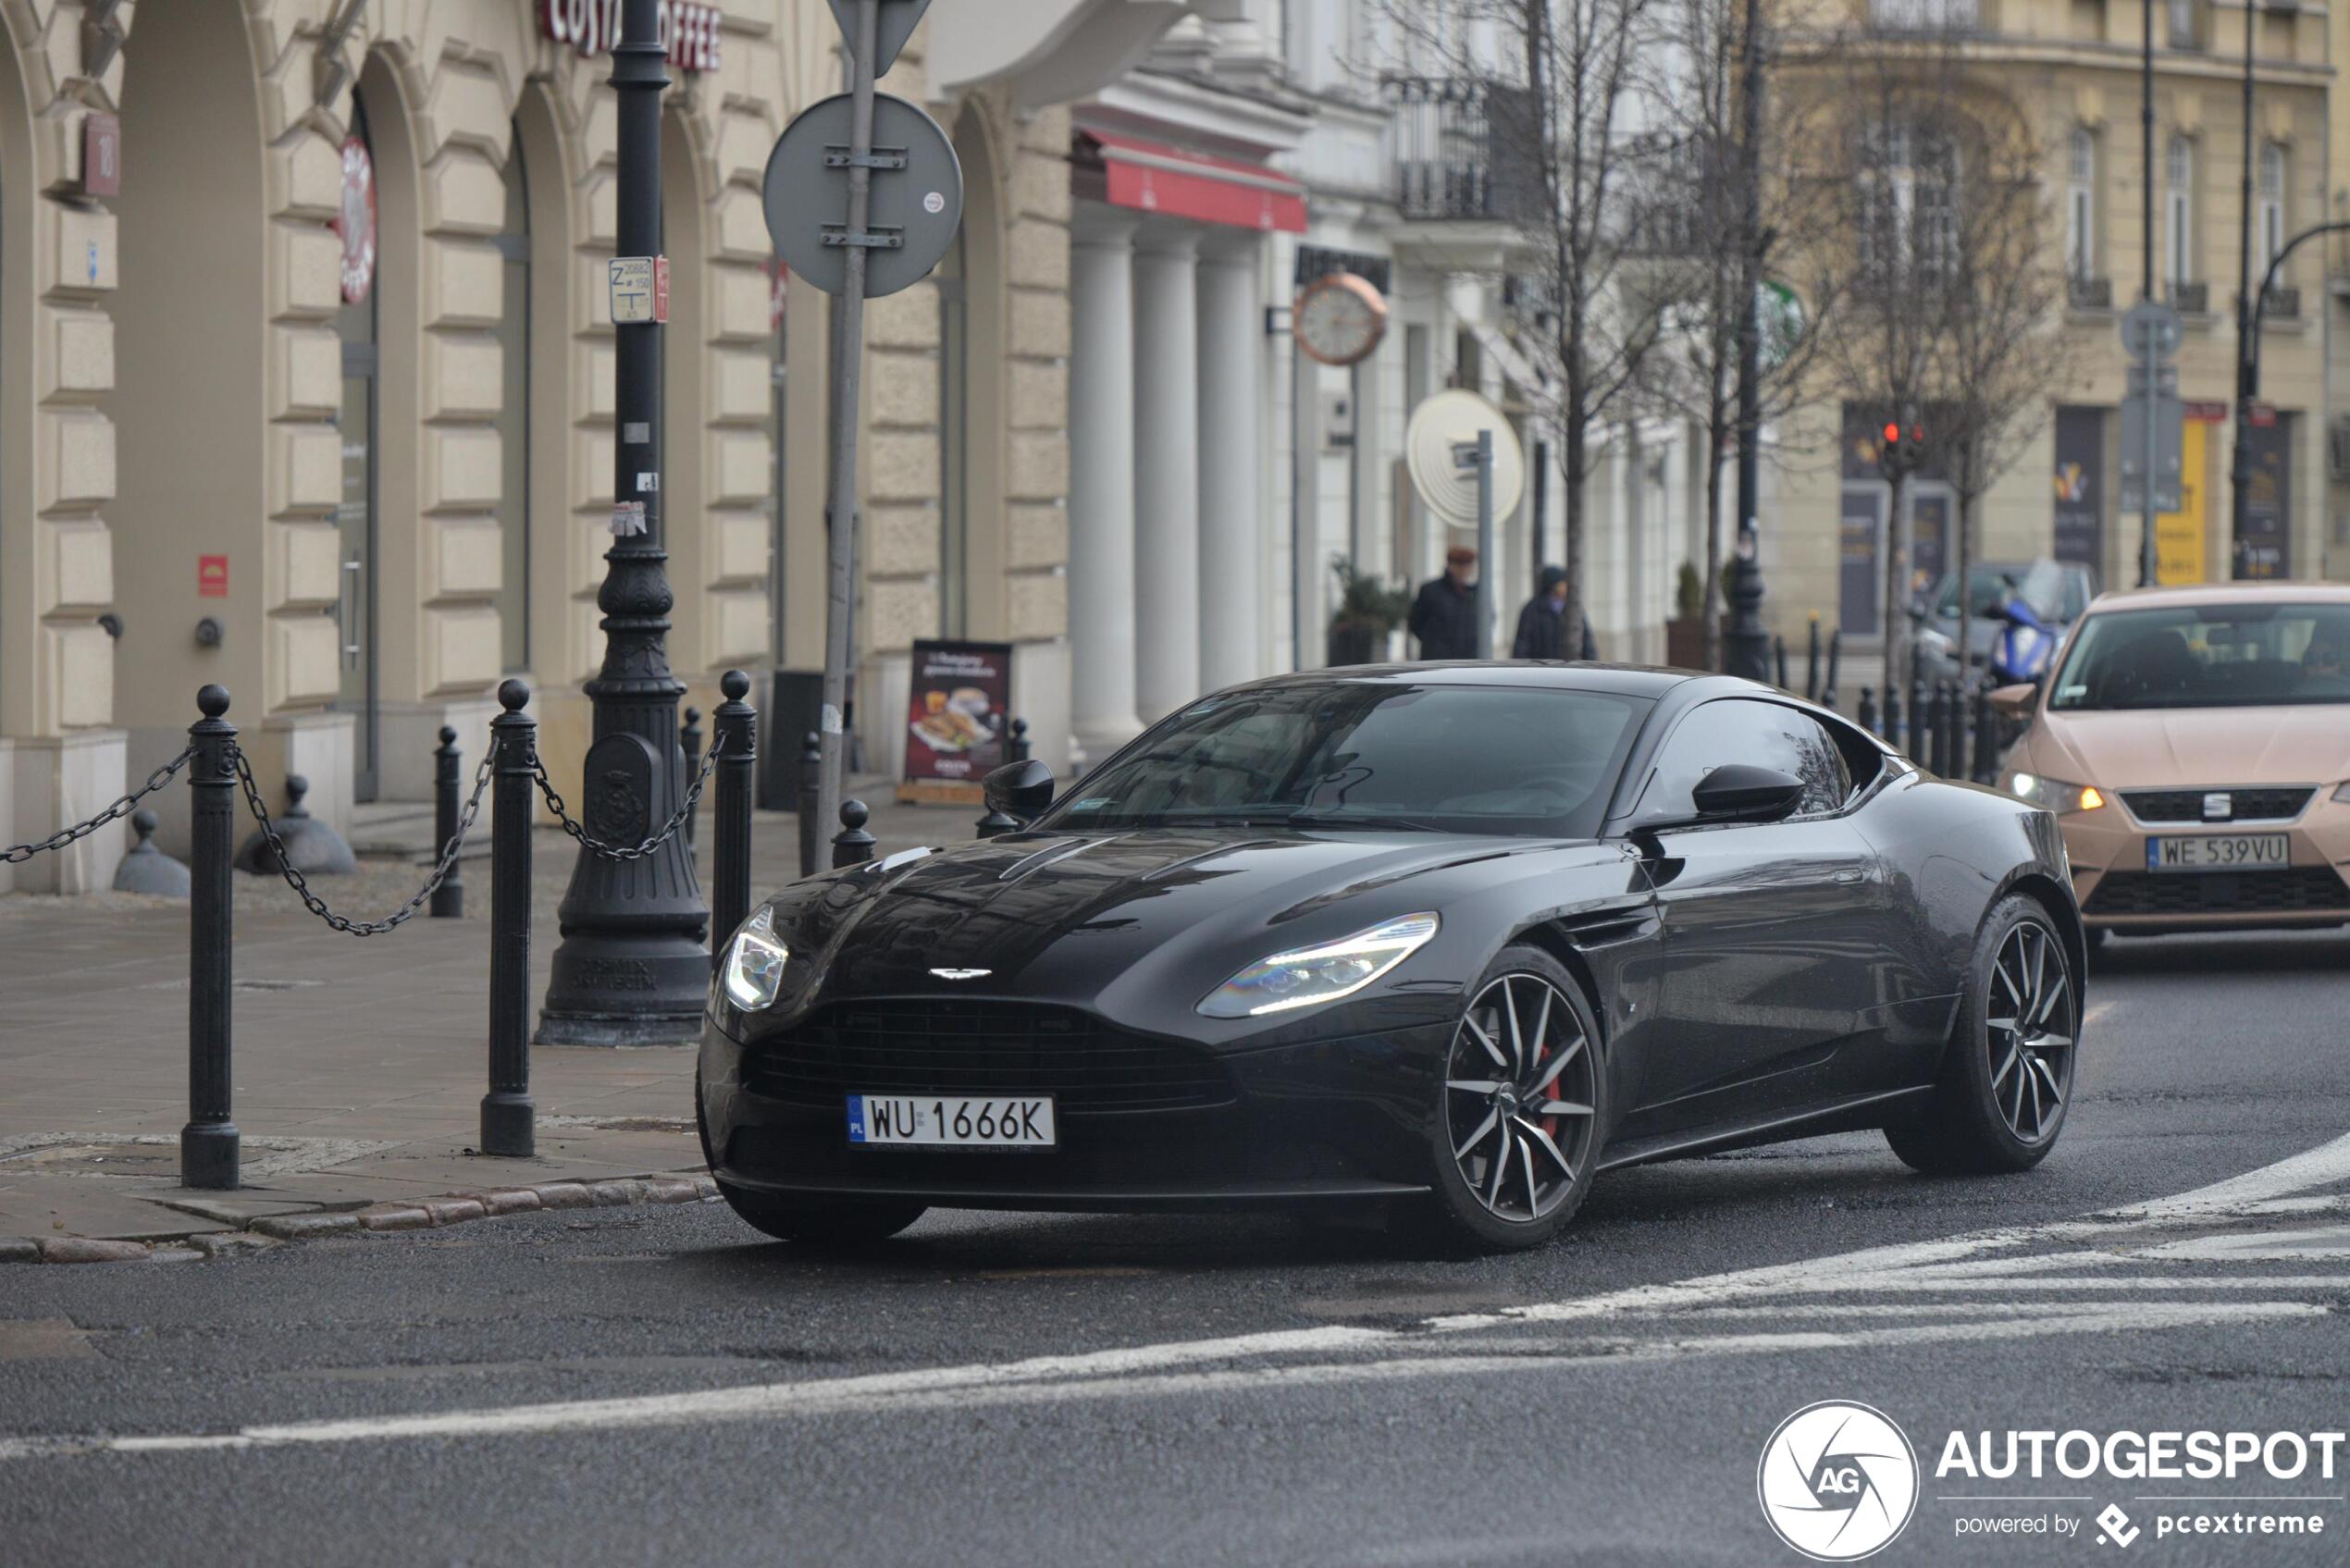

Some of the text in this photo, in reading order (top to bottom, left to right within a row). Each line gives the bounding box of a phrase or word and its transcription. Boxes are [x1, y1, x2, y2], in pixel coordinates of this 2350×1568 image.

[658, 0, 720, 69] OFFEE
[612, 267, 625, 285] Z
[2165, 837, 2282, 864] WE 539VU
[850, 1122, 863, 1134] PL
[871, 1099, 1045, 1141] WU 1666K
